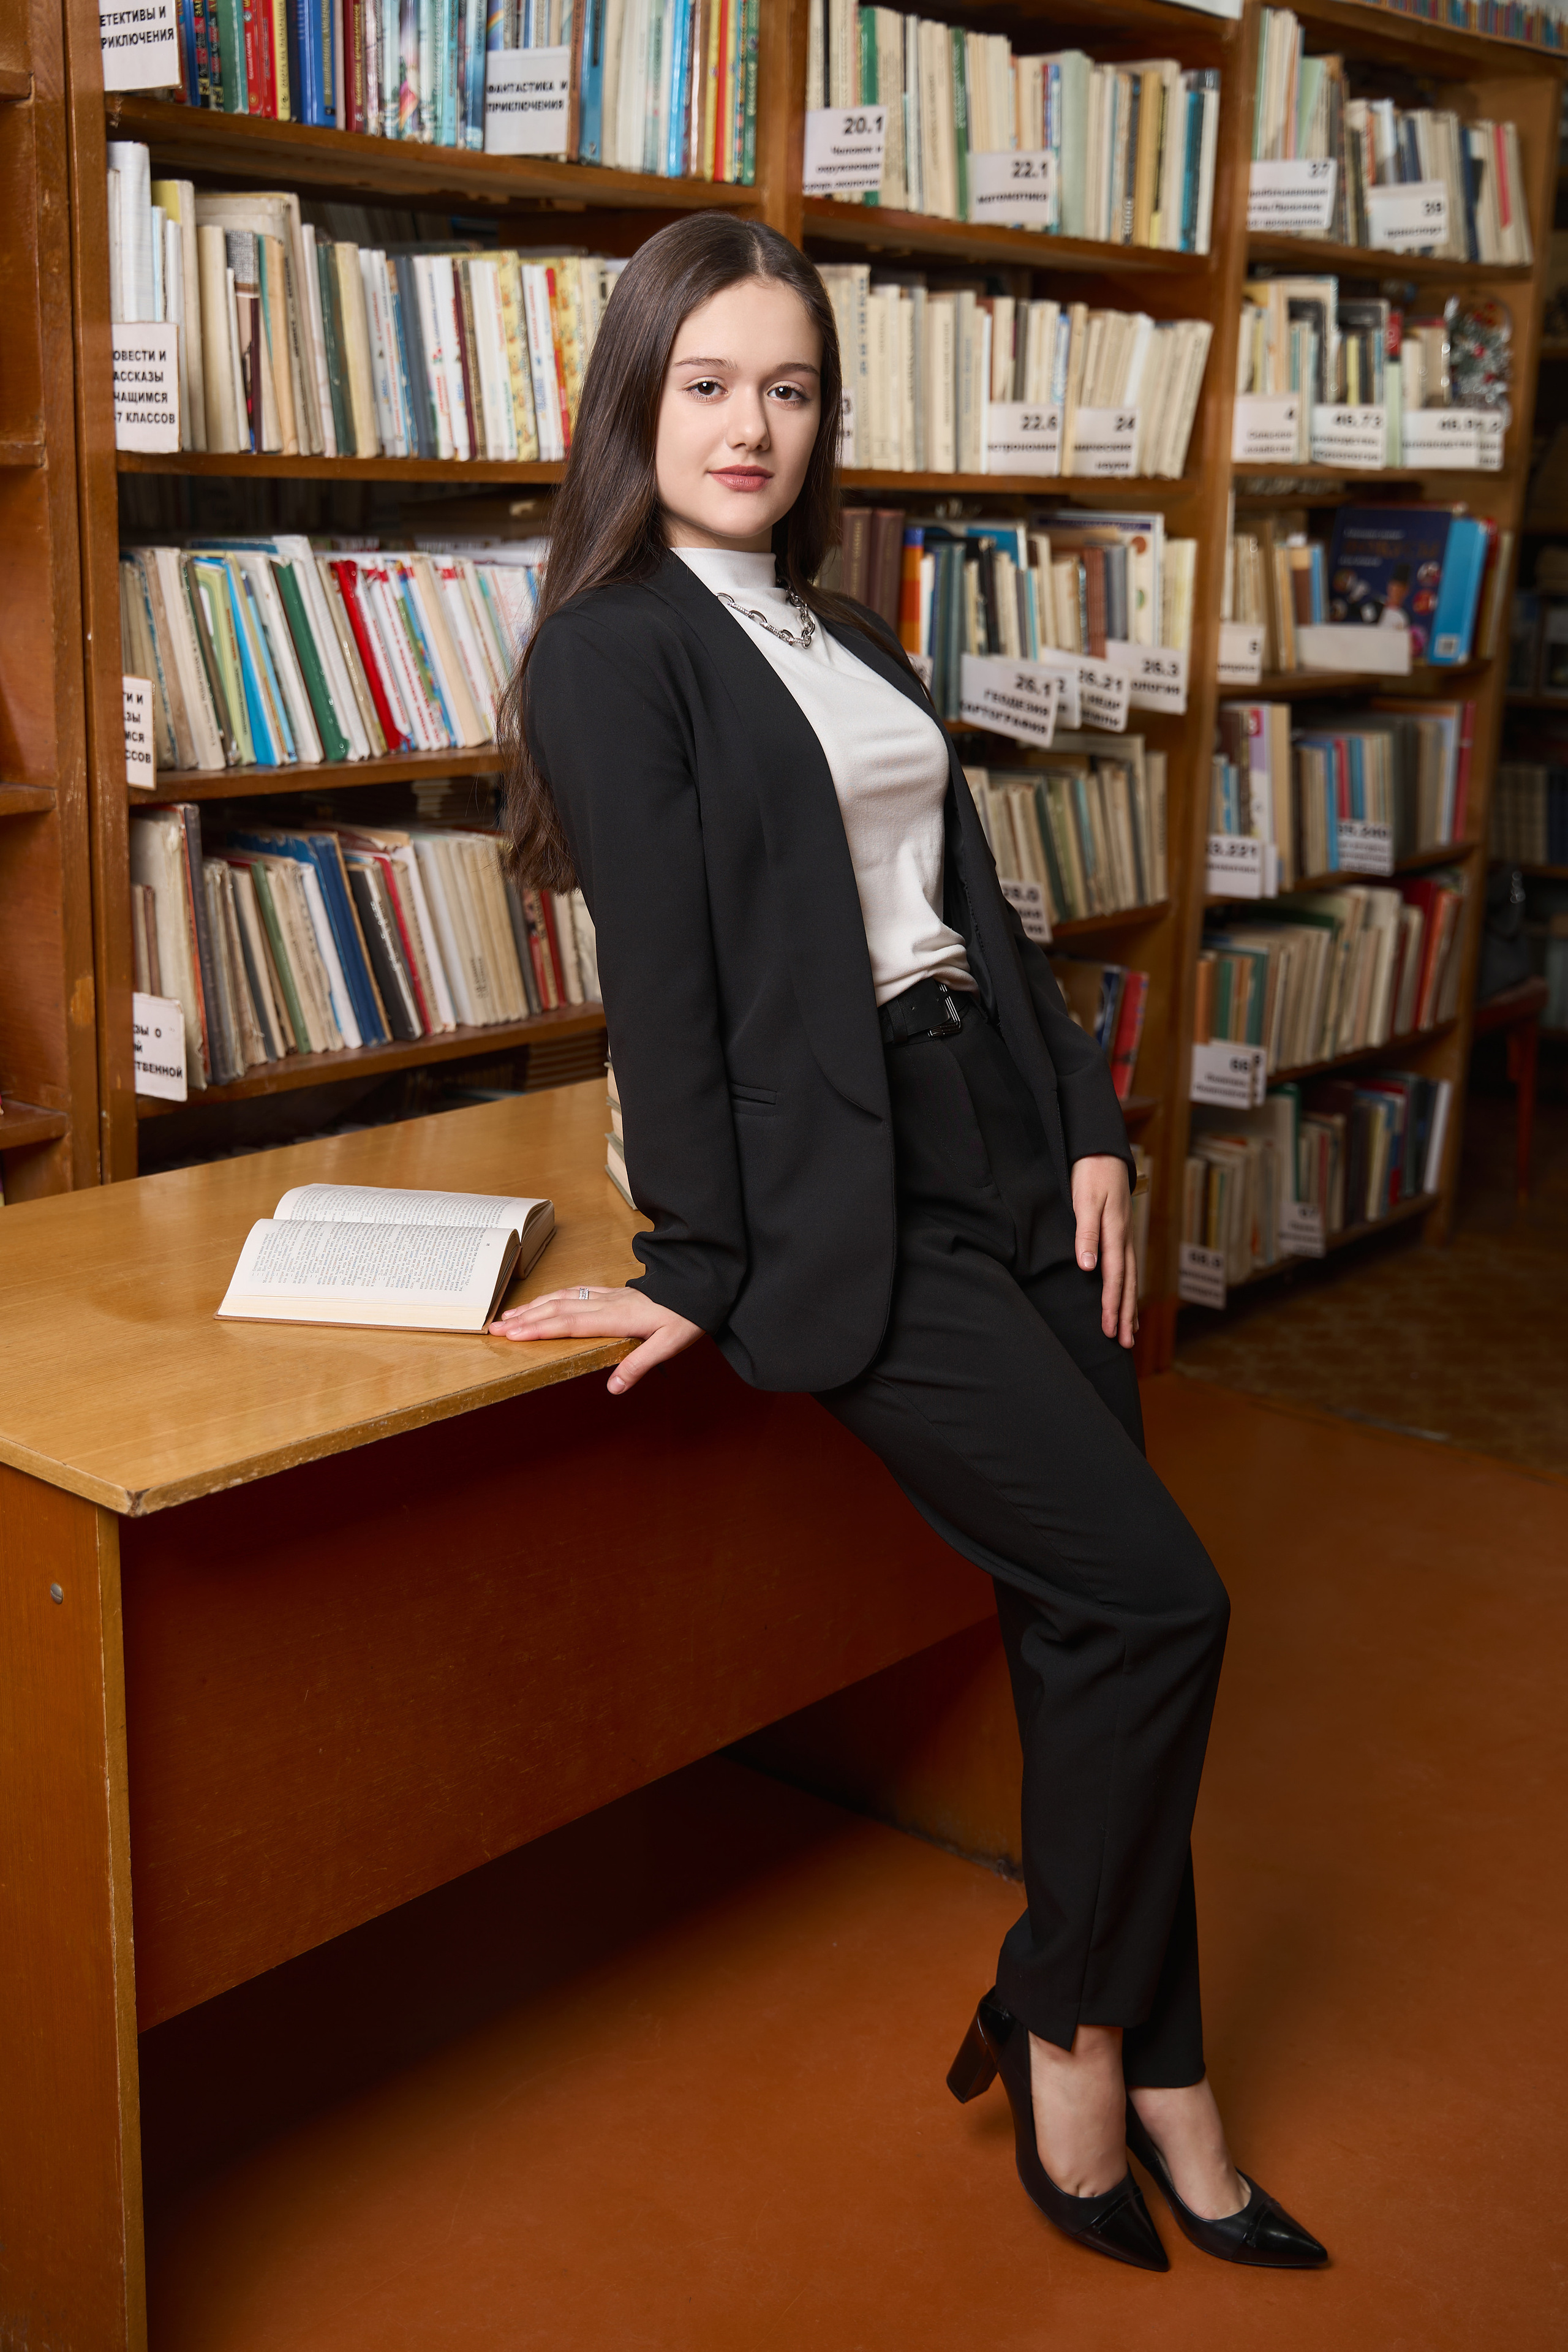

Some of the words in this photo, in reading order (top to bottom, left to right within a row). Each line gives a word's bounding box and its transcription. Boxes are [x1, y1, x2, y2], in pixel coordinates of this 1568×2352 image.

[100, 7, 156, 27] ЕТЕКТИВЫ
[159, 6, 167, 19] И
[101, 28, 175, 50] РИКЛЮЧЕНИЯ
[487, 81, 554, 94] ФАНТАСТИКА
[561, 80, 568, 91] И
[487, 99, 564, 113] ПРИКЛЮЧЕНИЯ
[844, 116, 883, 135] 20.1
[1013, 161, 1047, 178] 22.1
[113, 350, 155, 361] ОВЕСТИ
[159, 350, 167, 361] И
[113, 371, 164, 382] АССКАЗЫ
[114, 391, 168, 405] ЧАЩИМСЯ
[126, 413, 175, 424] КЛАССОВ
[137, 695, 143, 704] И
[134, 1061, 183, 1079] ТВЕННОЙ
